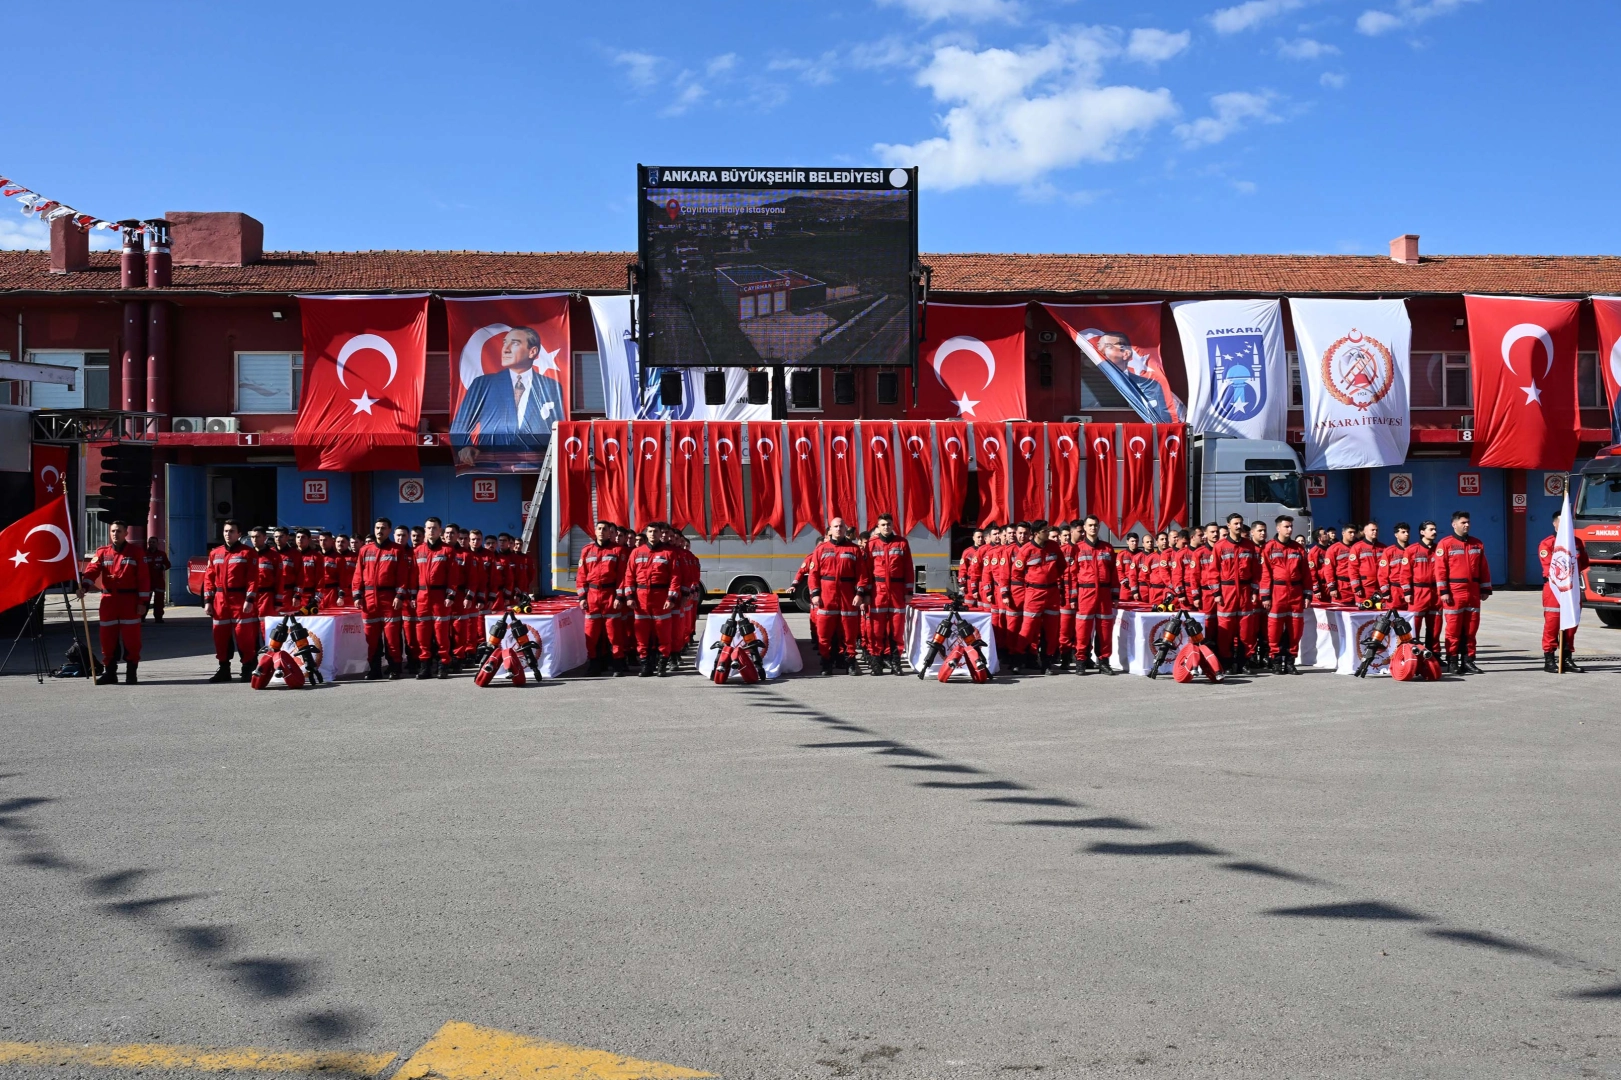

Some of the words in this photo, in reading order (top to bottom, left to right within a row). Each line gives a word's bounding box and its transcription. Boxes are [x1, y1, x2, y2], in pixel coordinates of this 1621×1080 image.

[662, 170, 718, 183] ANKARA
[721, 168, 806, 186] BÜYÜKŞEHİR
[809, 169, 884, 184] BELEDİYESİ
[1206, 327, 1263, 336] ANKARA
[1314, 418, 1360, 430] ANKARA
[245, 434, 252, 445] 1
[423, 434, 434, 445] 2
[1462, 430, 1472, 441] 8
[1462, 476, 1476, 486] 112
[308, 483, 323, 493] 112
[477, 482, 493, 492] 112
